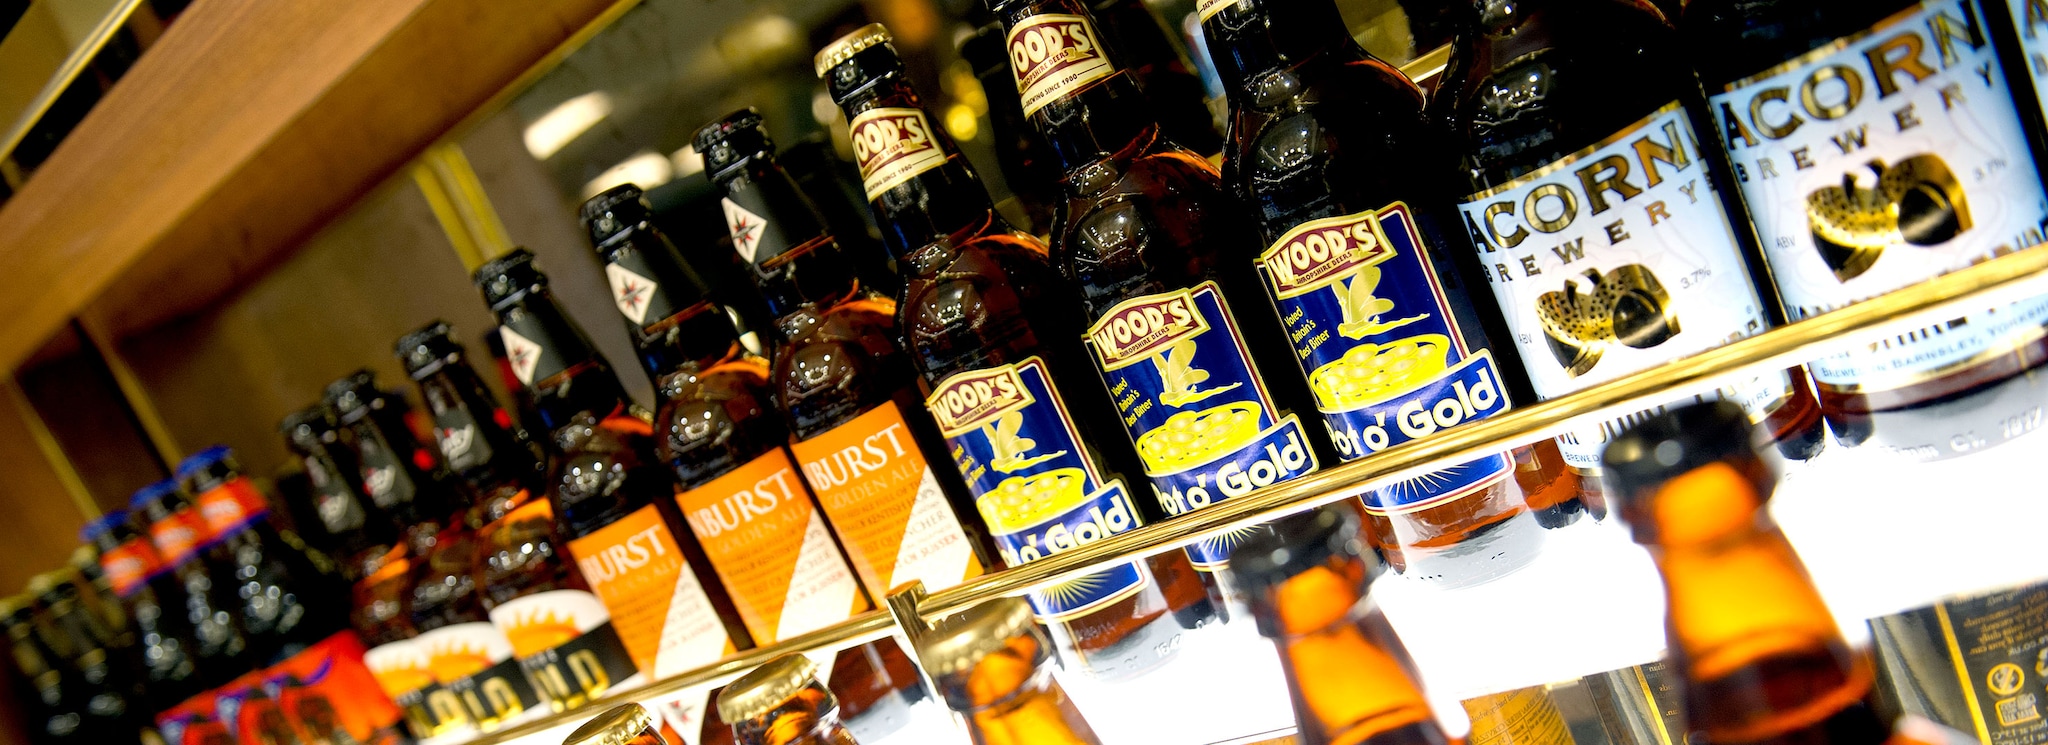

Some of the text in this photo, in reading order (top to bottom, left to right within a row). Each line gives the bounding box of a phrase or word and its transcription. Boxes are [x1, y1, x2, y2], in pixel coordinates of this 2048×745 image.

[1011, 24, 1092, 73] OOD'S
[1044, 82, 1062, 97] SINCE
[1062, 73, 1078, 86] 1980
[1721, 0, 1986, 150] ACORN
[853, 116, 927, 162] OOD'S
[1734, 60, 1996, 183] BREWERY
[1463, 119, 1691, 254] ACORN
[1267, 221, 1377, 284] WOOD'S
[1481, 178, 1697, 283] BREWERY
[1775, 234, 1796, 249] ABV
[1295, 264, 1331, 285] SHROPSHIRE
[1679, 265, 1712, 290] 3.7%
[1094, 299, 1192, 359] WOOD'S
[1284, 305, 1304, 328] Voted
[1291, 319, 1317, 344] Britain's
[1518, 332, 1532, 345] ABV
[1298, 329, 1331, 360] Best Bitter
[933, 374, 1019, 427] WOOD'S
[1396, 366, 1499, 439] Gold
[1215, 430, 1307, 499] Gold
[1566, 451, 1600, 463] BREWED
[828, 474, 888, 509] GOLDEN
[892, 457, 922, 483] ALE
[1044, 494, 1132, 555] Gold
